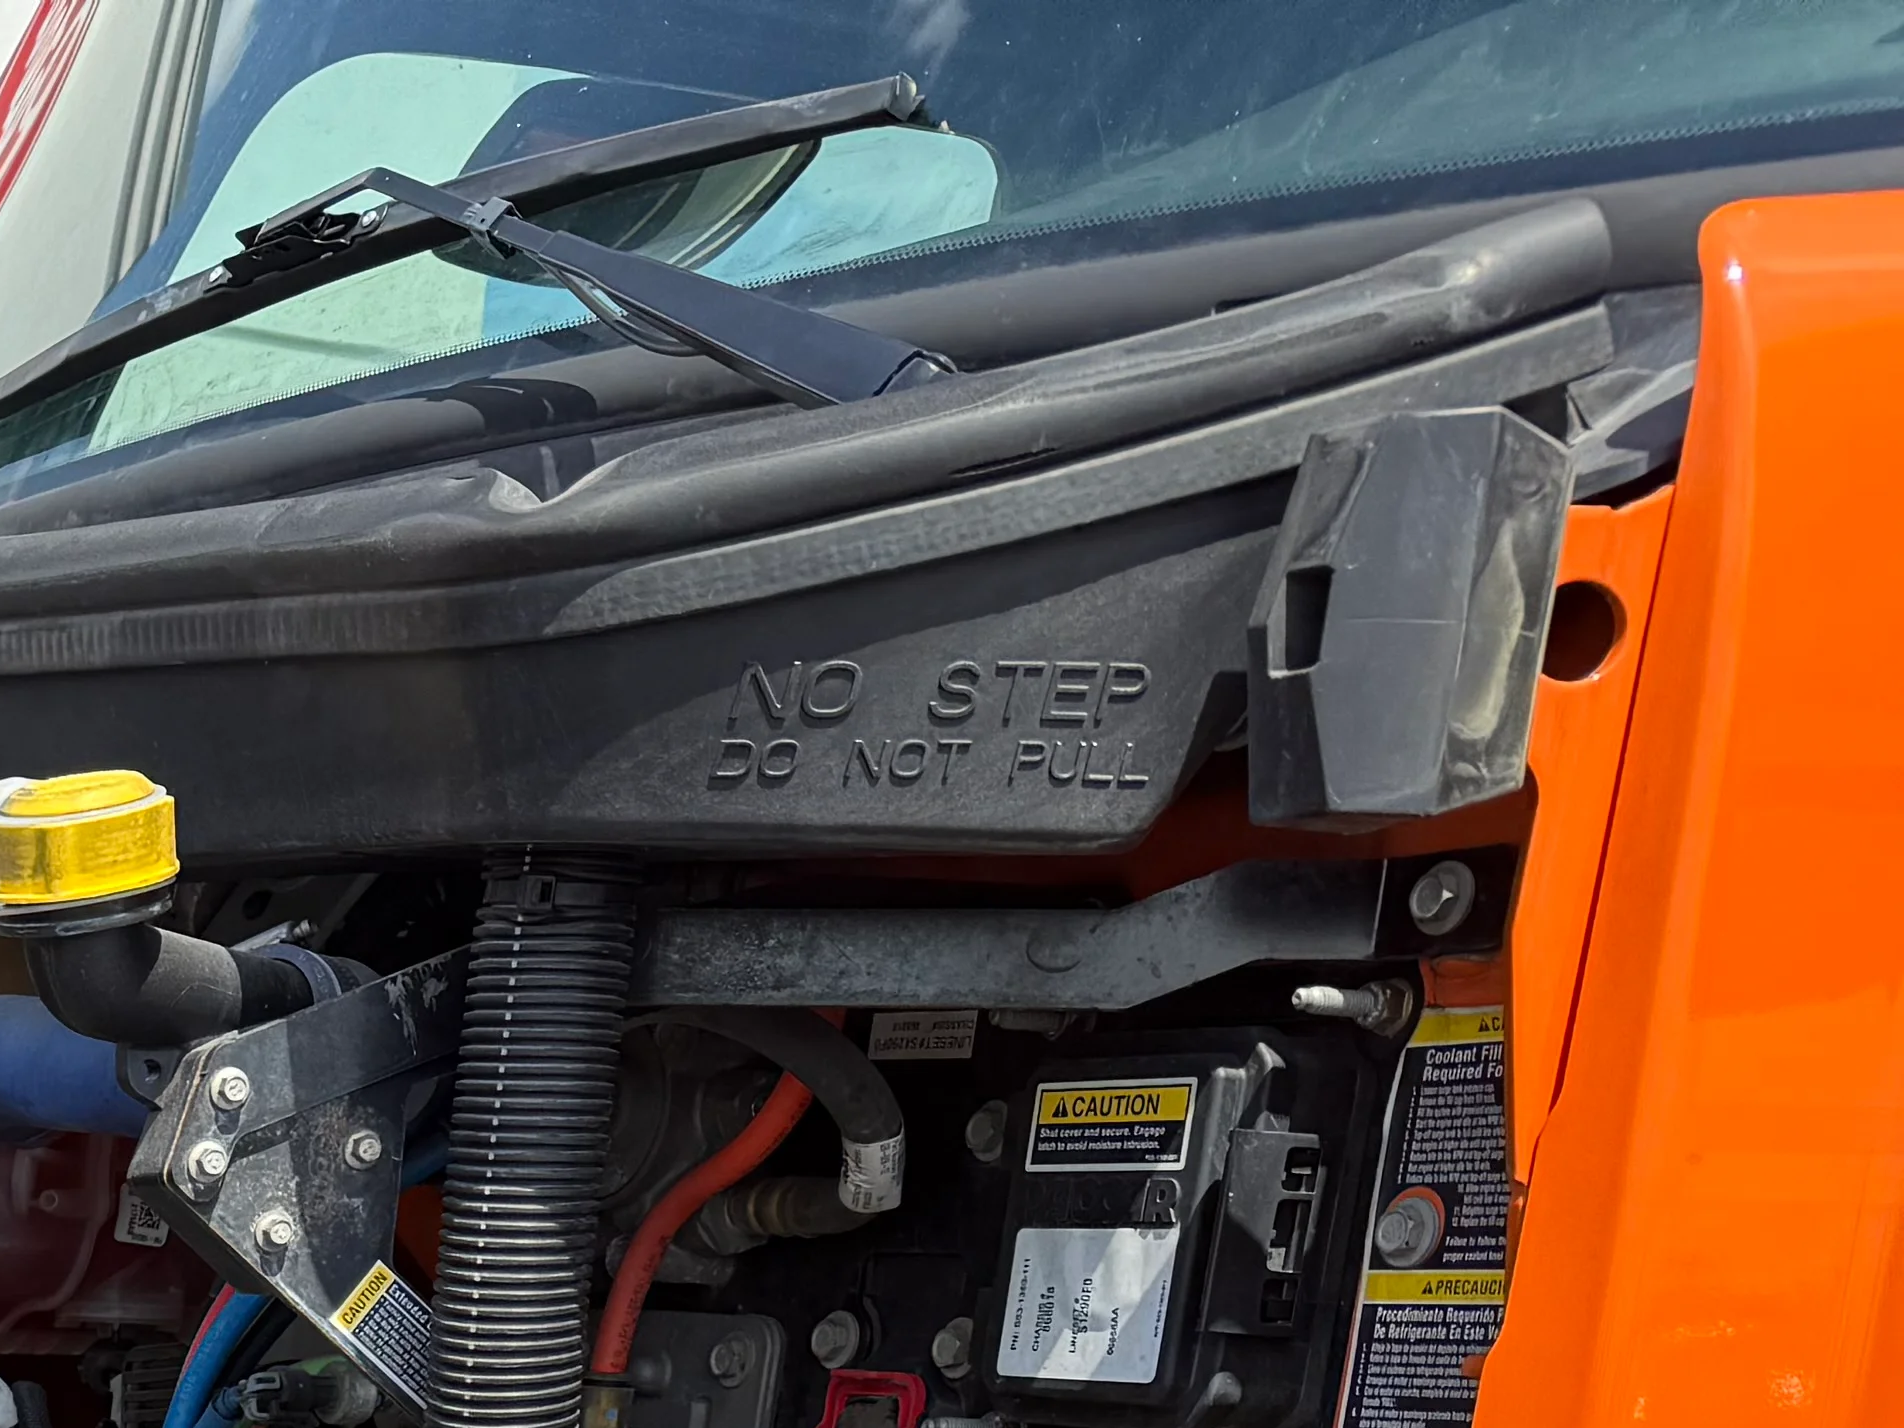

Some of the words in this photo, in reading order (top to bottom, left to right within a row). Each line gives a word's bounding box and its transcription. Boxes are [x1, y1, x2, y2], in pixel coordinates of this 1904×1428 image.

[727, 660, 863, 722] NO
[928, 661, 1152, 723] STEP
[708, 739, 799, 788] DO
[843, 739, 971, 786] NOT
[1007, 739, 1151, 786] PULL
[1426, 1047, 1476, 1064] Coolant
[1481, 1044, 1502, 1059] Fill
[1423, 1064, 1481, 1082] Required
[1487, 1064, 1503, 1077] Fo
[1072, 1094, 1161, 1117] CAUTION
[1084, 1127, 1100, 1136] and
[1435, 1280, 1505, 1296] PRECAUCI
[342, 1271, 388, 1325] CAUTION
[1376, 1307, 1445, 1323] Procedimiento
[1446, 1308, 1495, 1323] Requerido
[1374, 1325, 1386, 1339] De
[1388, 1325, 1447, 1341] Refrigerante
[1450, 1325, 1462, 1339] En
[1464, 1325, 1486, 1340] Este
